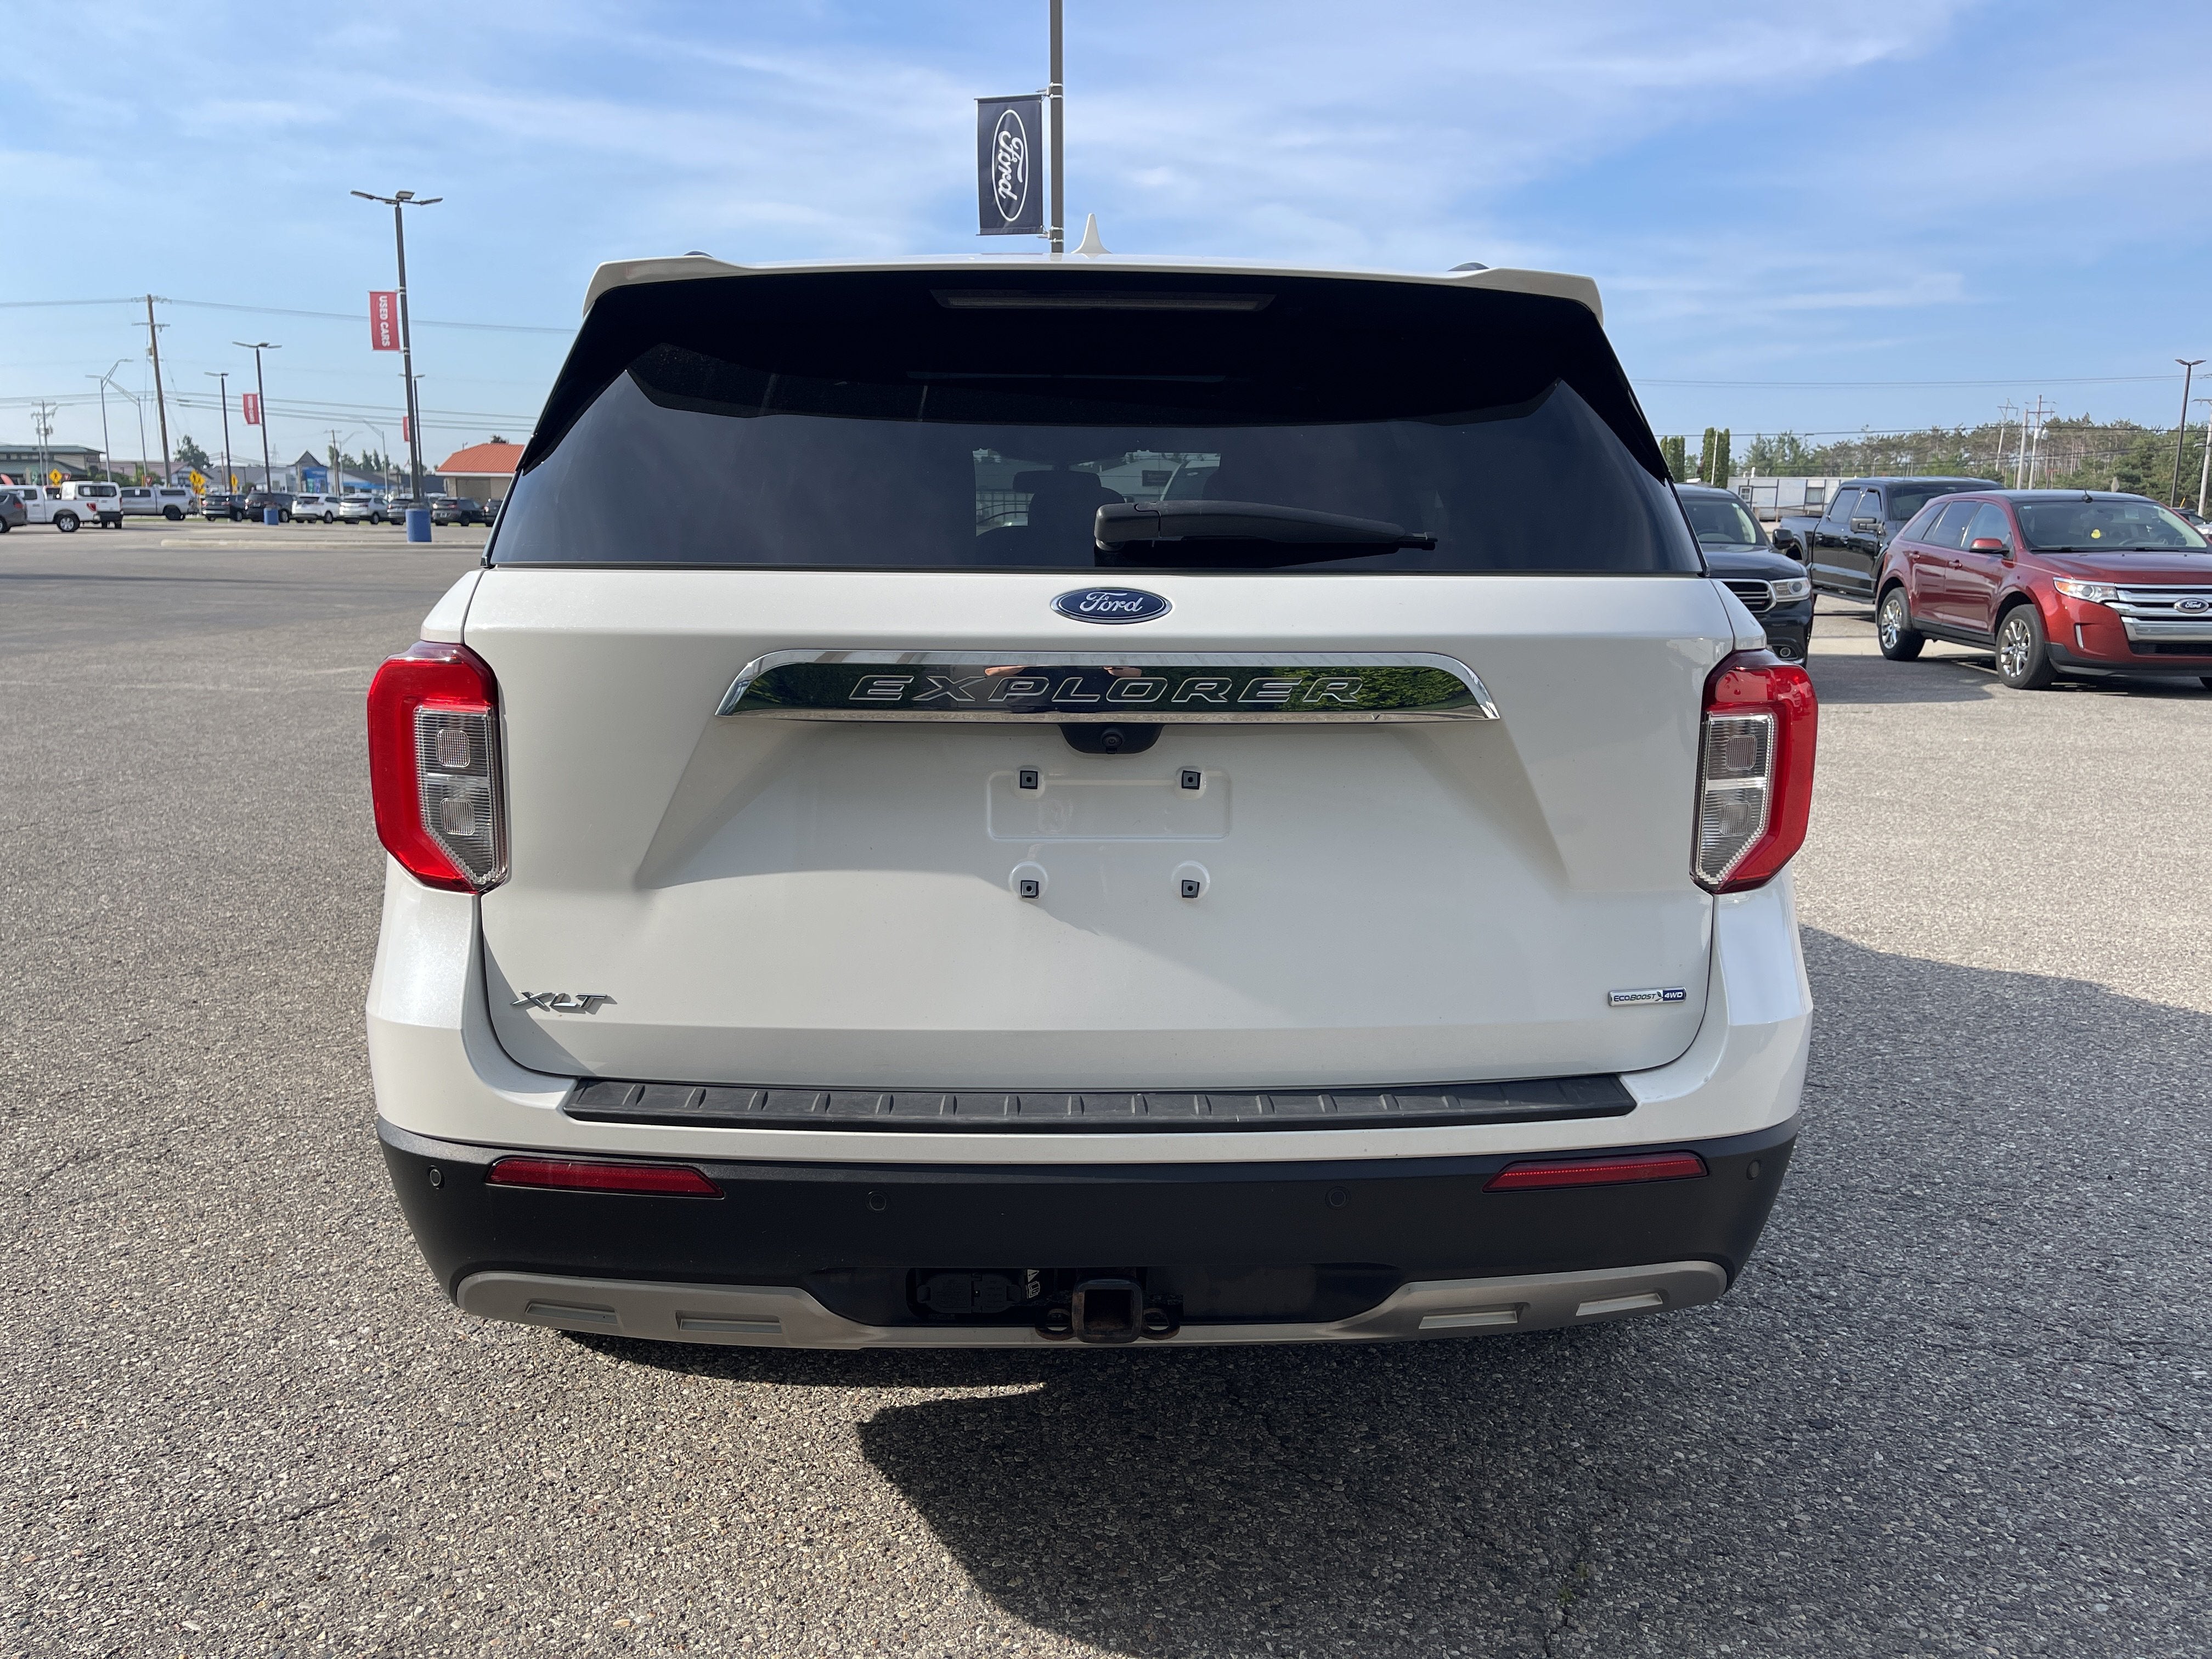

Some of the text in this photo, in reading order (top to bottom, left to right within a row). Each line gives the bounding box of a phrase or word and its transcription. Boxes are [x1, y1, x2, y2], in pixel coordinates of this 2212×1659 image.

[998, 130, 1024, 200] Ford
[379, 295, 391, 347] USED CARS
[1079, 591, 1144, 612] Ford
[849, 674, 1363, 703] EXPLORER
[510, 990, 607, 1009] XLT
[1613, 994, 1657, 1002] ECOBOOST
